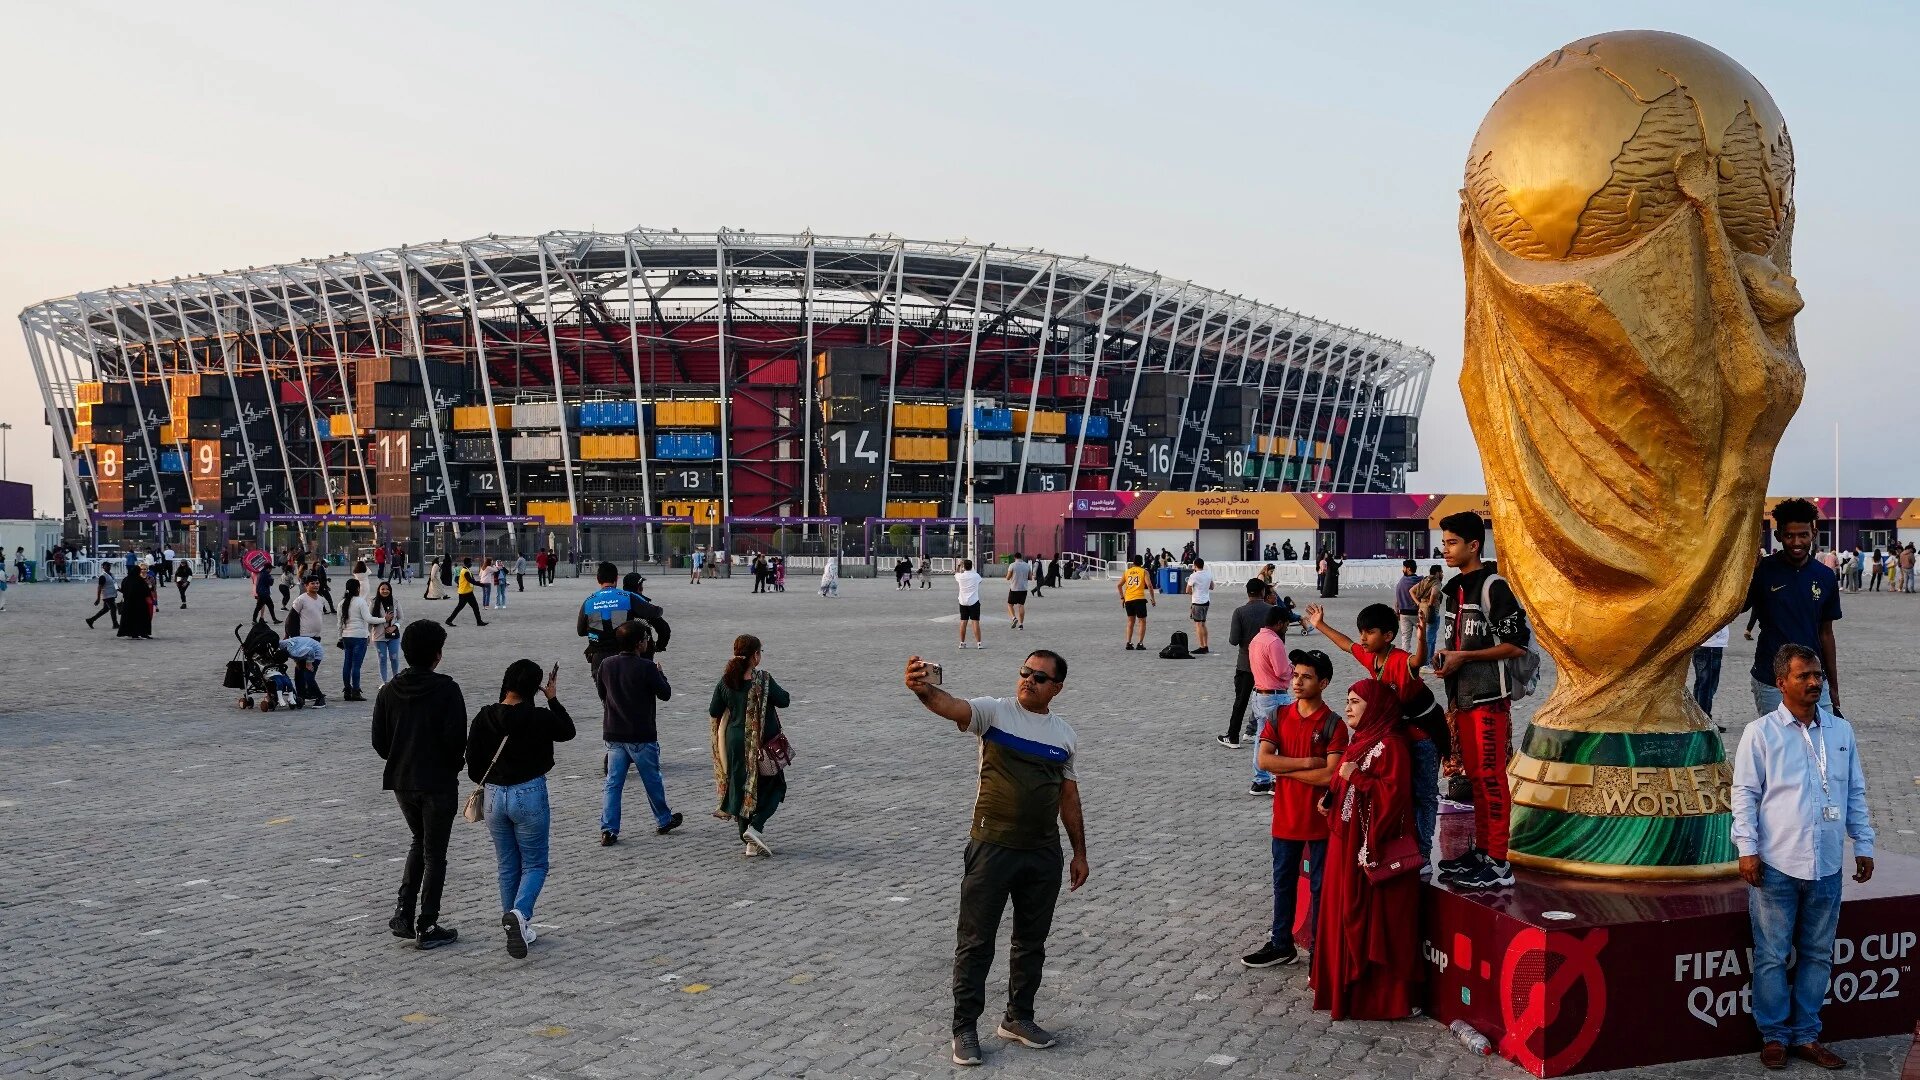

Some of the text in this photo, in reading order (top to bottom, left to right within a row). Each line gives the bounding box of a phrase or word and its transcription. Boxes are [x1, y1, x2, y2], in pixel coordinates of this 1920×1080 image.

[199, 444, 213, 474] 9
[379, 434, 407, 468] 11
[830, 430, 879, 464] 14
[1149, 443, 1169, 473] 16
[104, 449, 117, 477] 8
[1225, 450, 1242, 477] 18
[479, 473, 494, 490] 12
[679, 470, 700, 488] 13
[1040, 474, 1055, 491] 15
[1392, 467, 1403, 489] 21
[1186, 508, 1224, 516] Spectator
[1127, 575, 1140, 586] 24
[1631, 764, 1733, 791] FIFA
[1602, 789, 1717, 816] WORLD
[1423, 939, 1449, 974] Cup
[1675, 949, 1742, 982] FIFA
[1860, 931, 1917, 962] CUP
[1687, 981, 1753, 1028] Qat
